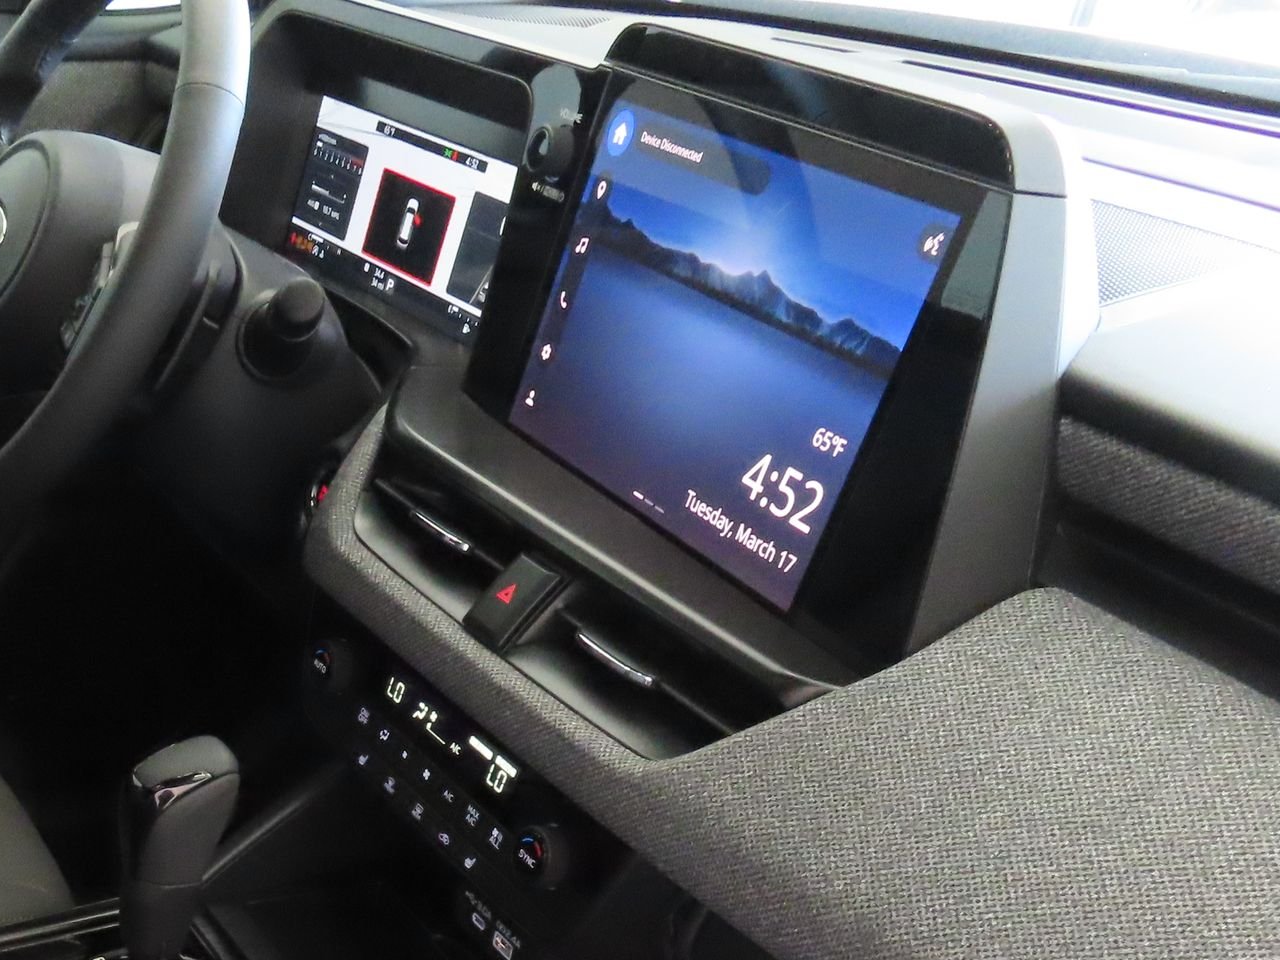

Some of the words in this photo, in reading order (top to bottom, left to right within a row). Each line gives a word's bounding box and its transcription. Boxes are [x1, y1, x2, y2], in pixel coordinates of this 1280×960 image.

[641, 131, 662, 148] Device
[660, 138, 704, 163] Disconnected
[385, 279, 395, 291] P
[812, 427, 848, 457] 65°F
[741, 454, 824, 535] 4:52
[685, 489, 734, 538] Tuesday,
[735, 523, 776, 562] March
[778, 551, 798, 573] 17
[518, 848, 537, 869] SYNC
